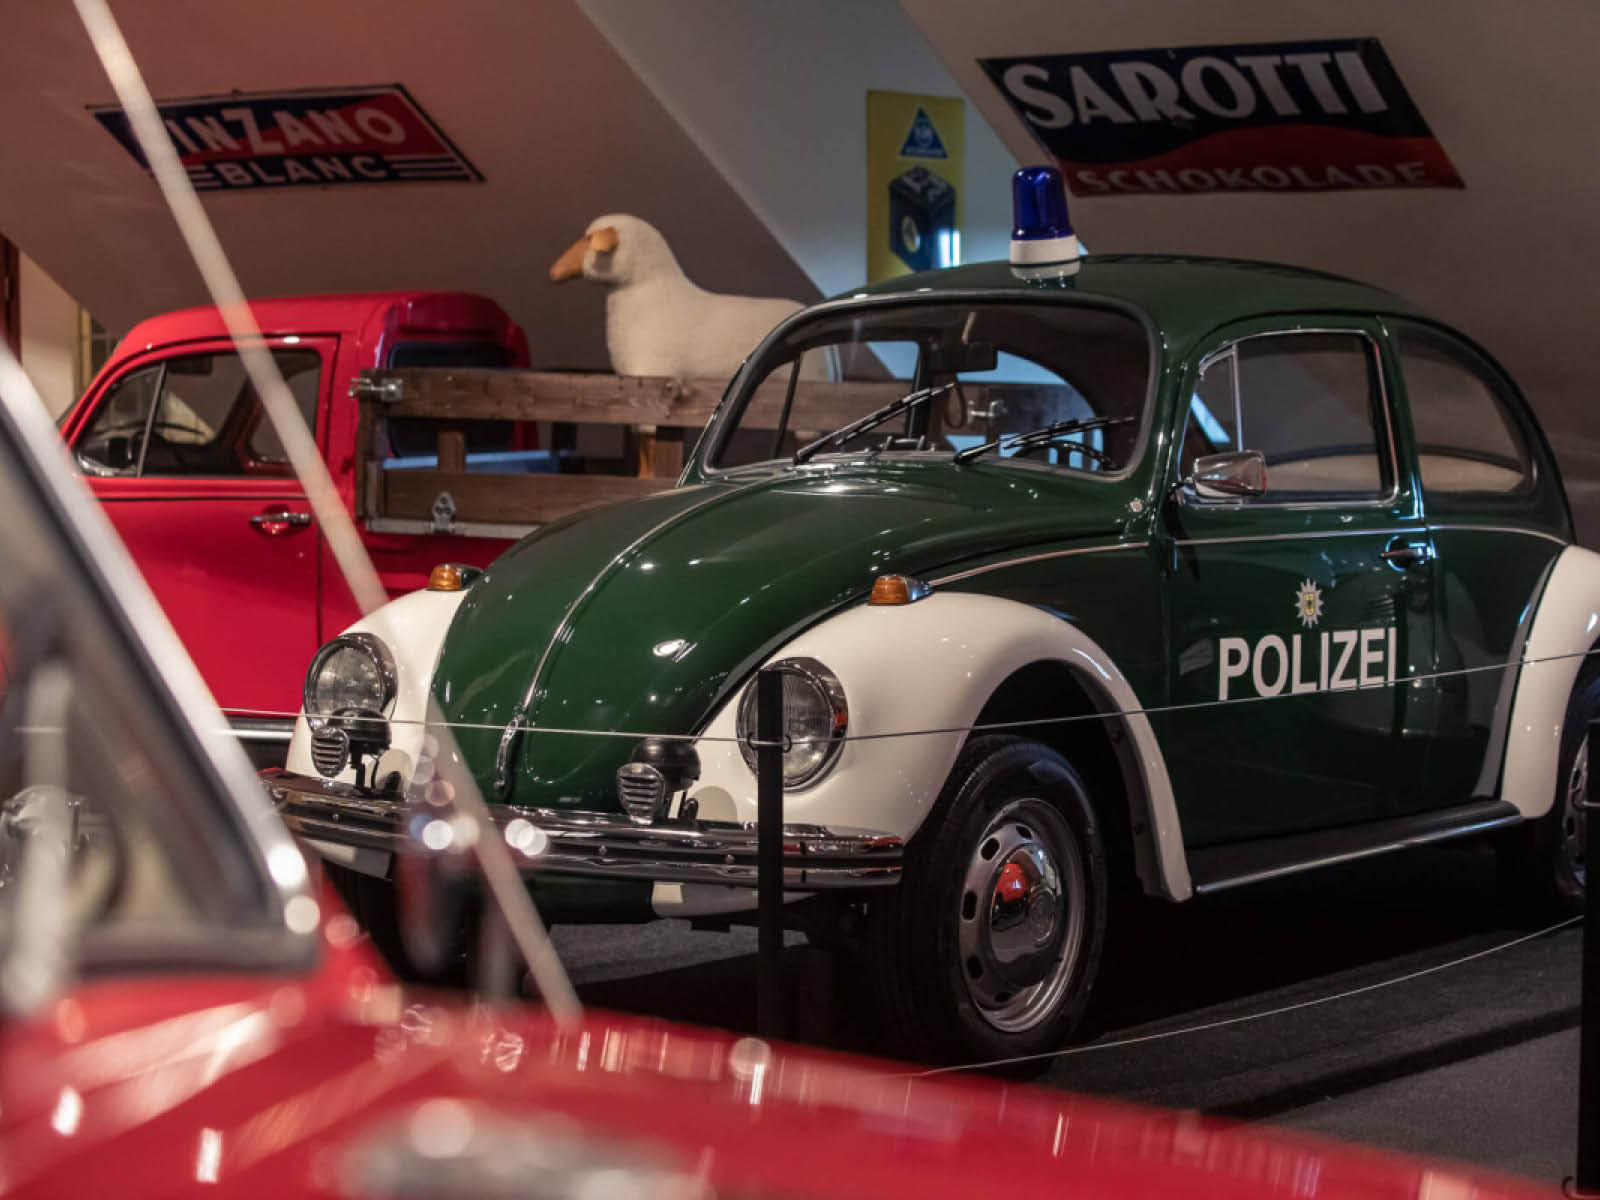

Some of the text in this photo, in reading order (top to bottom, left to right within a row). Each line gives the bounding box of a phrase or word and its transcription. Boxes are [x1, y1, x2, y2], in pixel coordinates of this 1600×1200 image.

[1003, 51, 1390, 129] SAROTTI
[164, 107, 407, 156] INZANO
[213, 154, 389, 186] BLANC
[1075, 160, 1428, 193] SCHOKOLADE
[1218, 626, 1398, 701] POLIZEI
